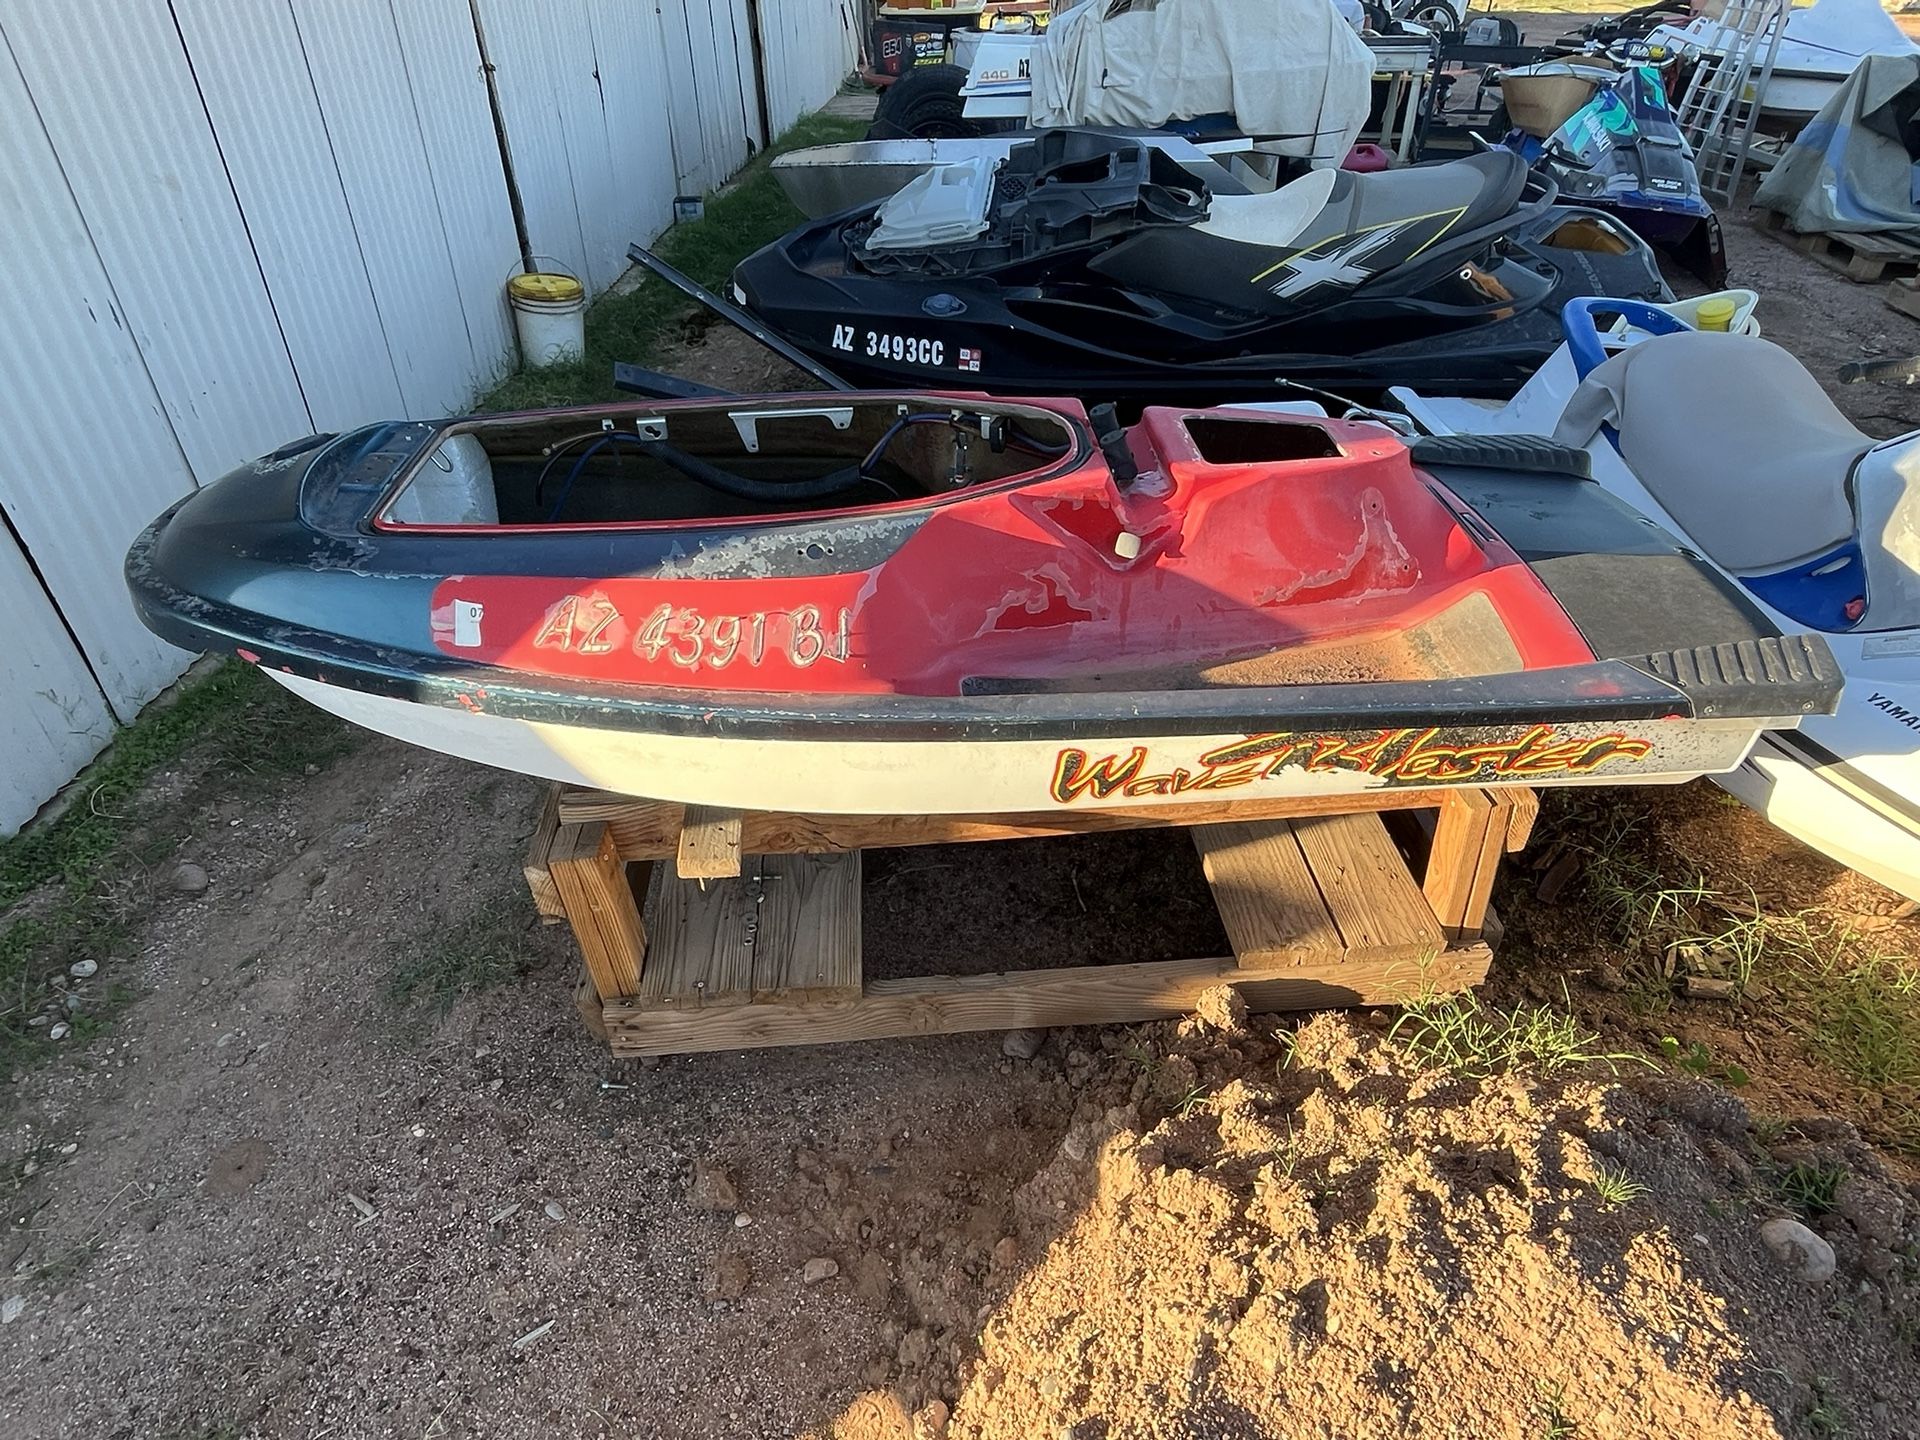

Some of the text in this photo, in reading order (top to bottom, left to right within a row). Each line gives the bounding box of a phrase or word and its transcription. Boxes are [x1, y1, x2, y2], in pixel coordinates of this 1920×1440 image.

[981, 70, 1008, 80] 440
[1018, 58, 1031, 78] AZ
[832, 324, 944, 366] AZ 3493CC
[534, 595, 621, 655] AZ
[635, 602, 766, 668] 4391
